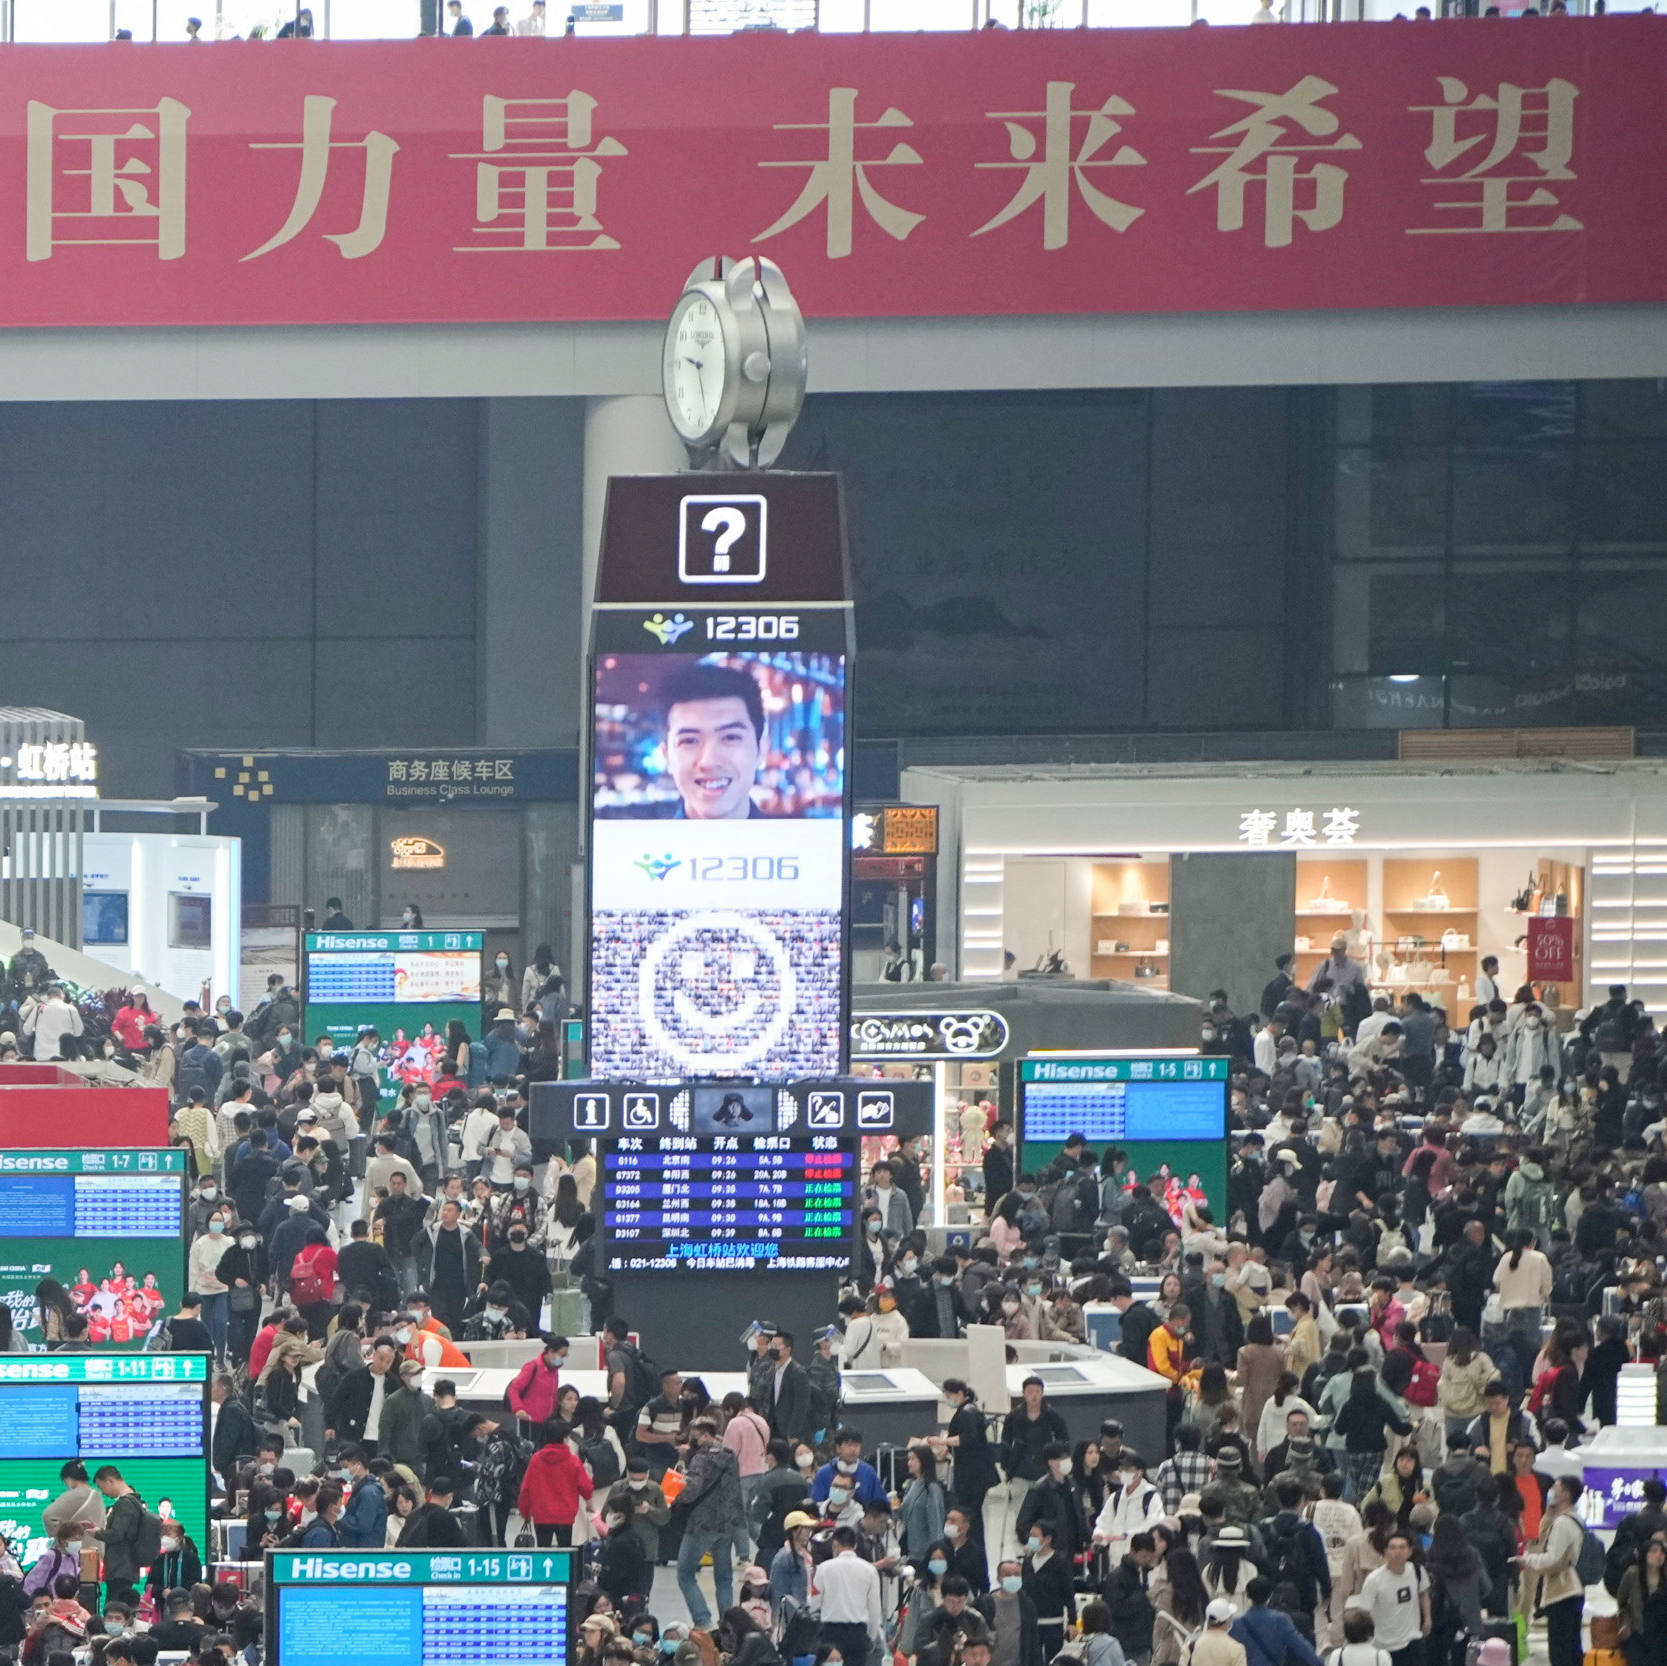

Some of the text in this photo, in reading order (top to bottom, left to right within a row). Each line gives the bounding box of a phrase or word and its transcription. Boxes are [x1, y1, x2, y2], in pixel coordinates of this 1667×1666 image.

[752, 77, 1584, 258] 未来希望
[706, 616, 799, 640] 12306
[388, 760, 514, 781] 商务座候车区
[387, 784, 514, 796] Business Class Lounge
[1239, 808, 1360, 847] 奢奥荟
[690, 857, 799, 880] 12306
[316, 936, 433, 949] Hisense 1
[1535, 947, 1563, 960] OFF
[1034, 1063, 1177, 1079] Hisense 1-5
[618, 1137, 643, 1151] 车次
[812, 1136, 838, 1150] 状态
[113, 1155, 129, 1168] 1-7
[666, 1243, 779, 1258] 上海虹桥站欢迎您
[118, 1361, 146, 1376] 1-11
[291, 1556, 500, 1578] Hisense 检票口 1-15
